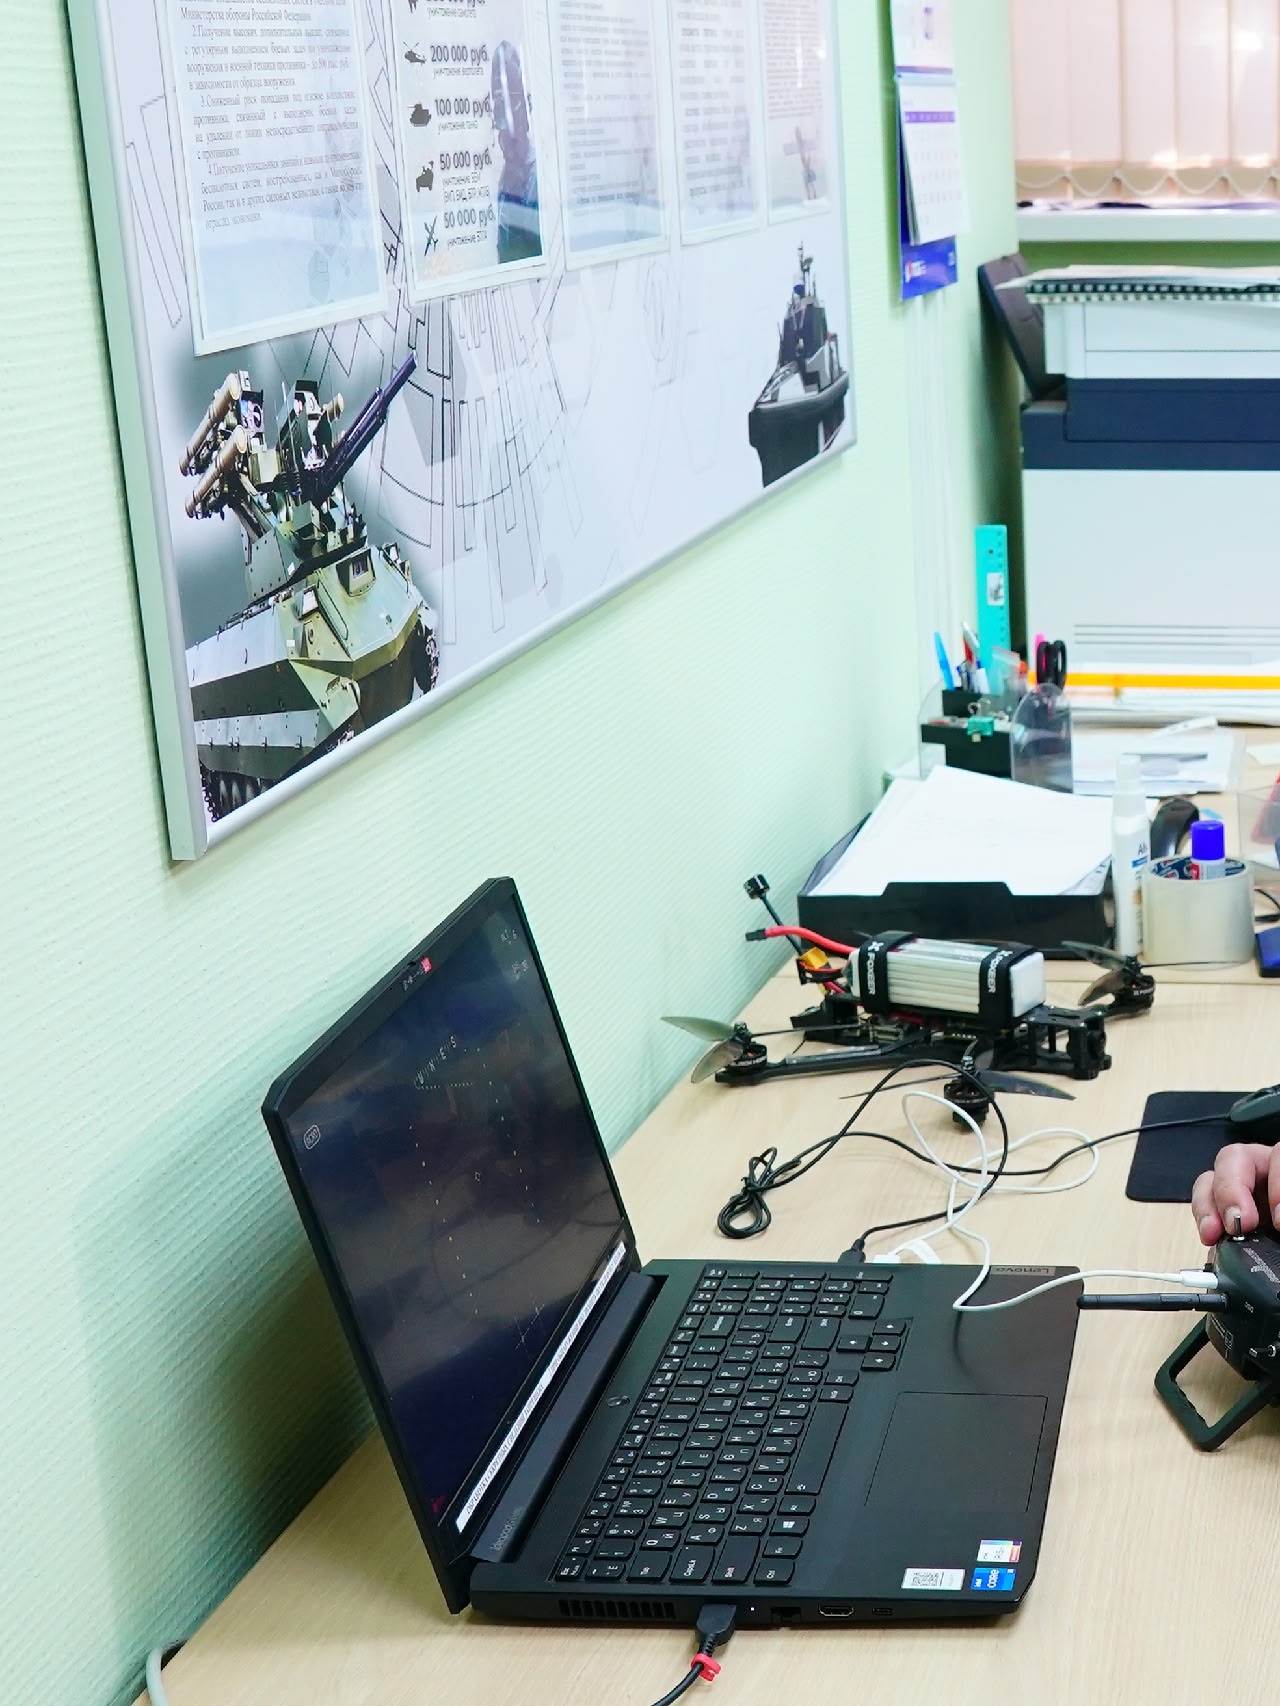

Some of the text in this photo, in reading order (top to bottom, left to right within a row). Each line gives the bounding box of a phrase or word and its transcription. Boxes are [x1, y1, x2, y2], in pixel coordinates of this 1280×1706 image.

[430, 44, 490, 66] 200 000 руб.
[435, 98, 451, 115] 100
[455, 98, 470, 115] 000
[440, 148, 492, 171] 50 000 руб.
[444, 204, 496, 229] 50 000 руб.
